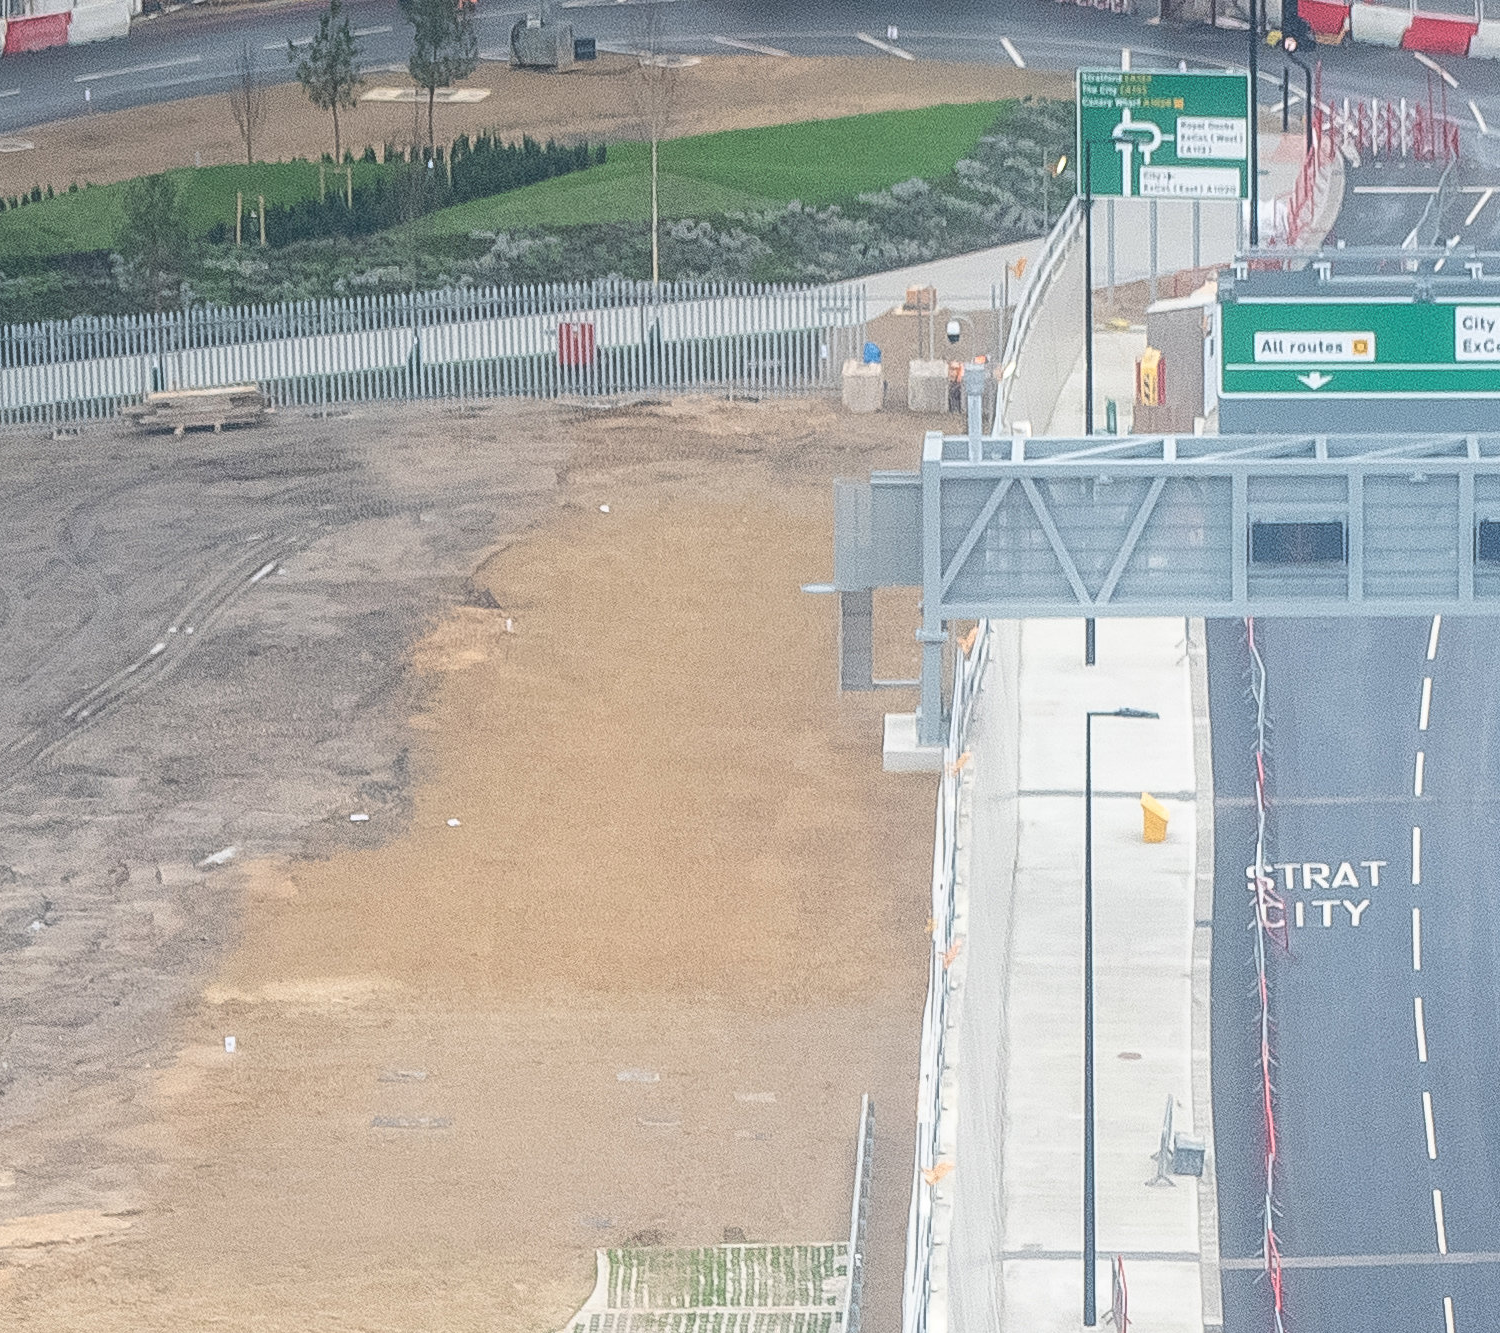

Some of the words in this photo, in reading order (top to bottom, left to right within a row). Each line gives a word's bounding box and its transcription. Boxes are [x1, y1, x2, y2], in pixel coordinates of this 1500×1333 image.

[1462, 316, 1496, 331] City
[1261, 340, 1283, 353] All
[1290, 341, 1343, 354] routes
[1245, 861, 1387, 891] STRAT
[1261, 899, 1371, 928] CITY
